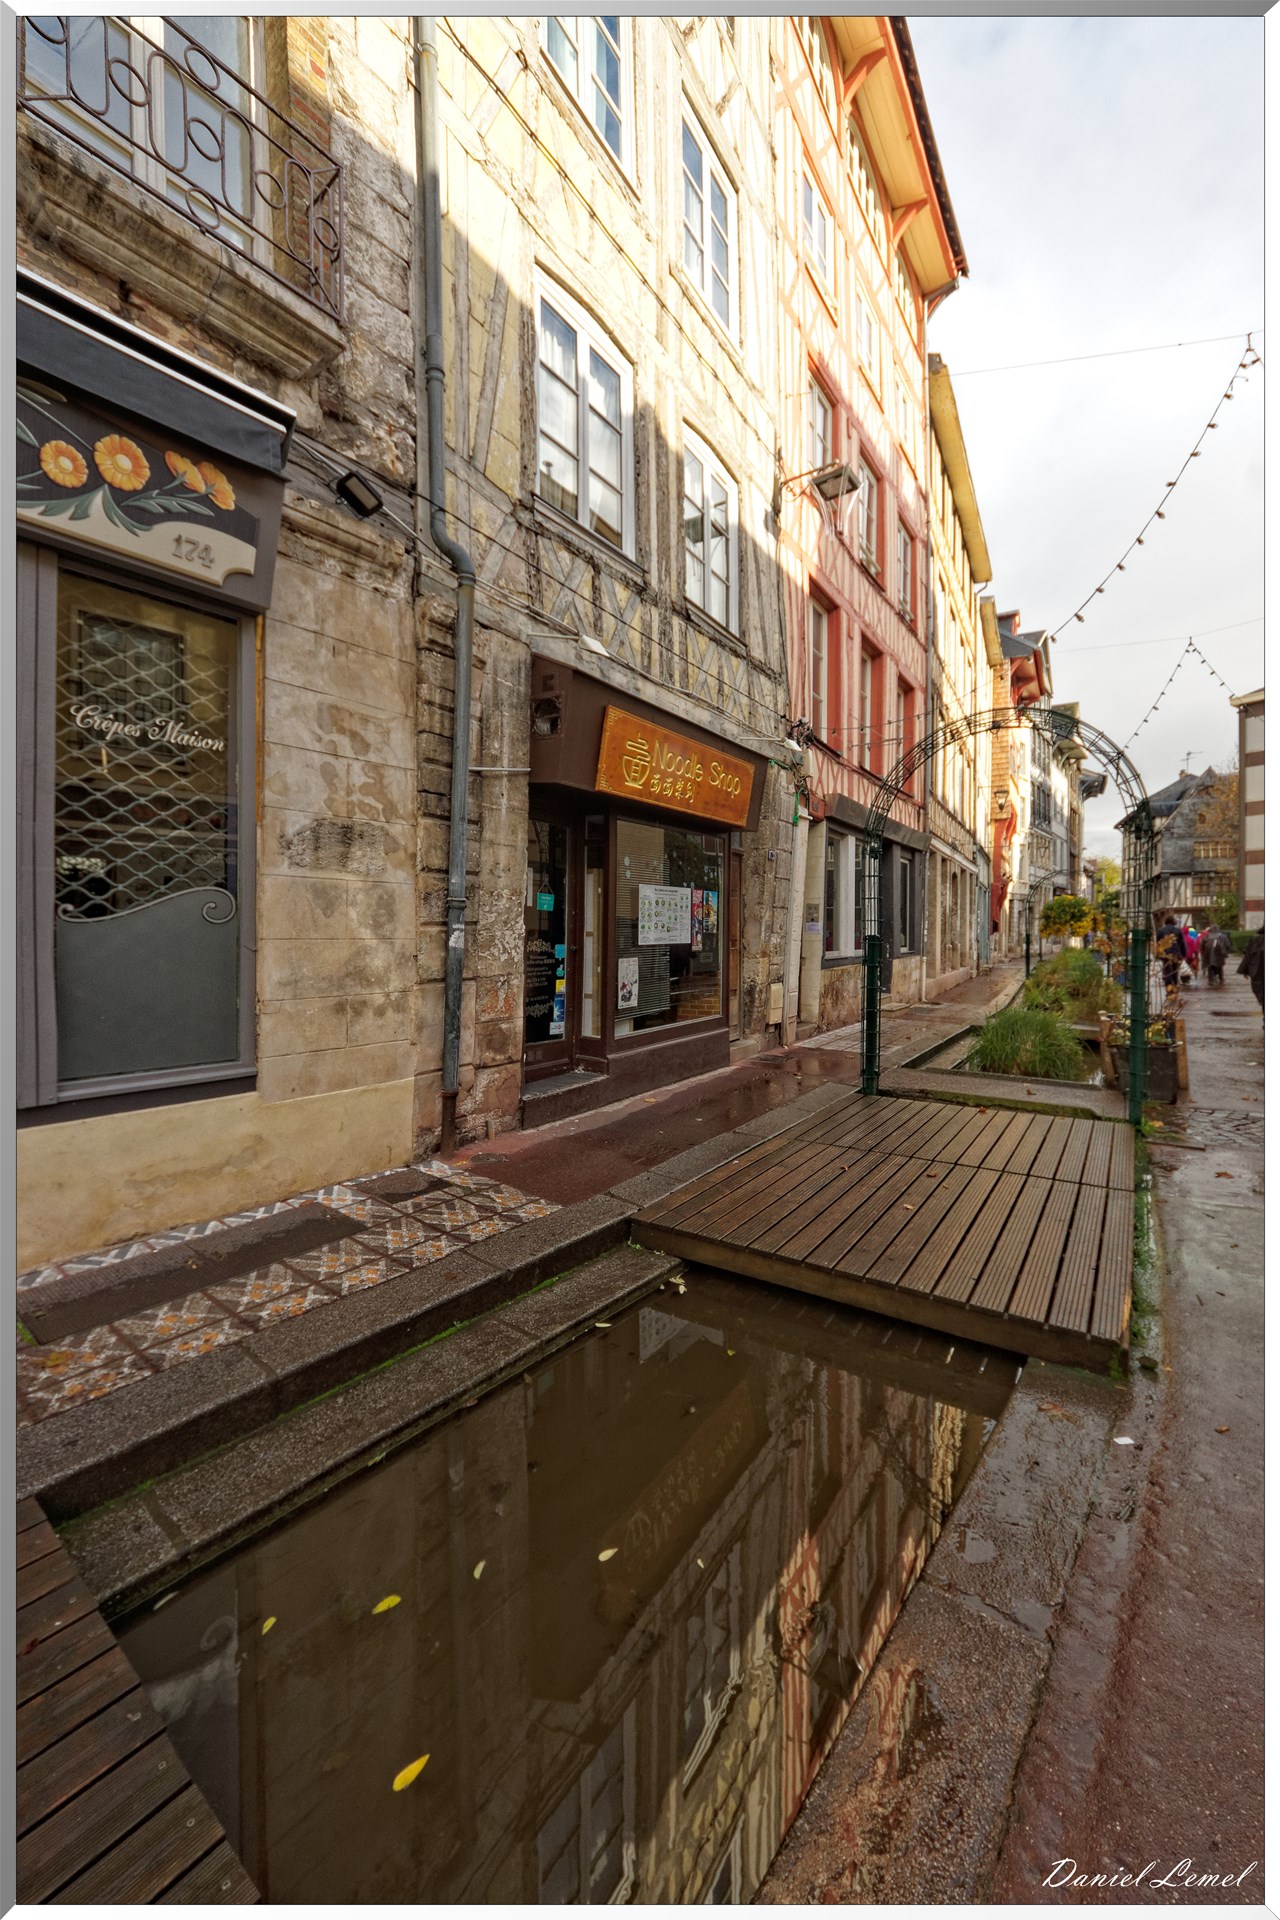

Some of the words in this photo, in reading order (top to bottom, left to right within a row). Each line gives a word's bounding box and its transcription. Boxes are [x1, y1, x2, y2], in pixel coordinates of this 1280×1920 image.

[172, 533, 214, 569] 174
[69, 704, 141, 740] Crêpes
[147, 716, 226, 752] Maison
[652, 738, 704, 782] Noodle
[708, 761, 741, 799] Shop
